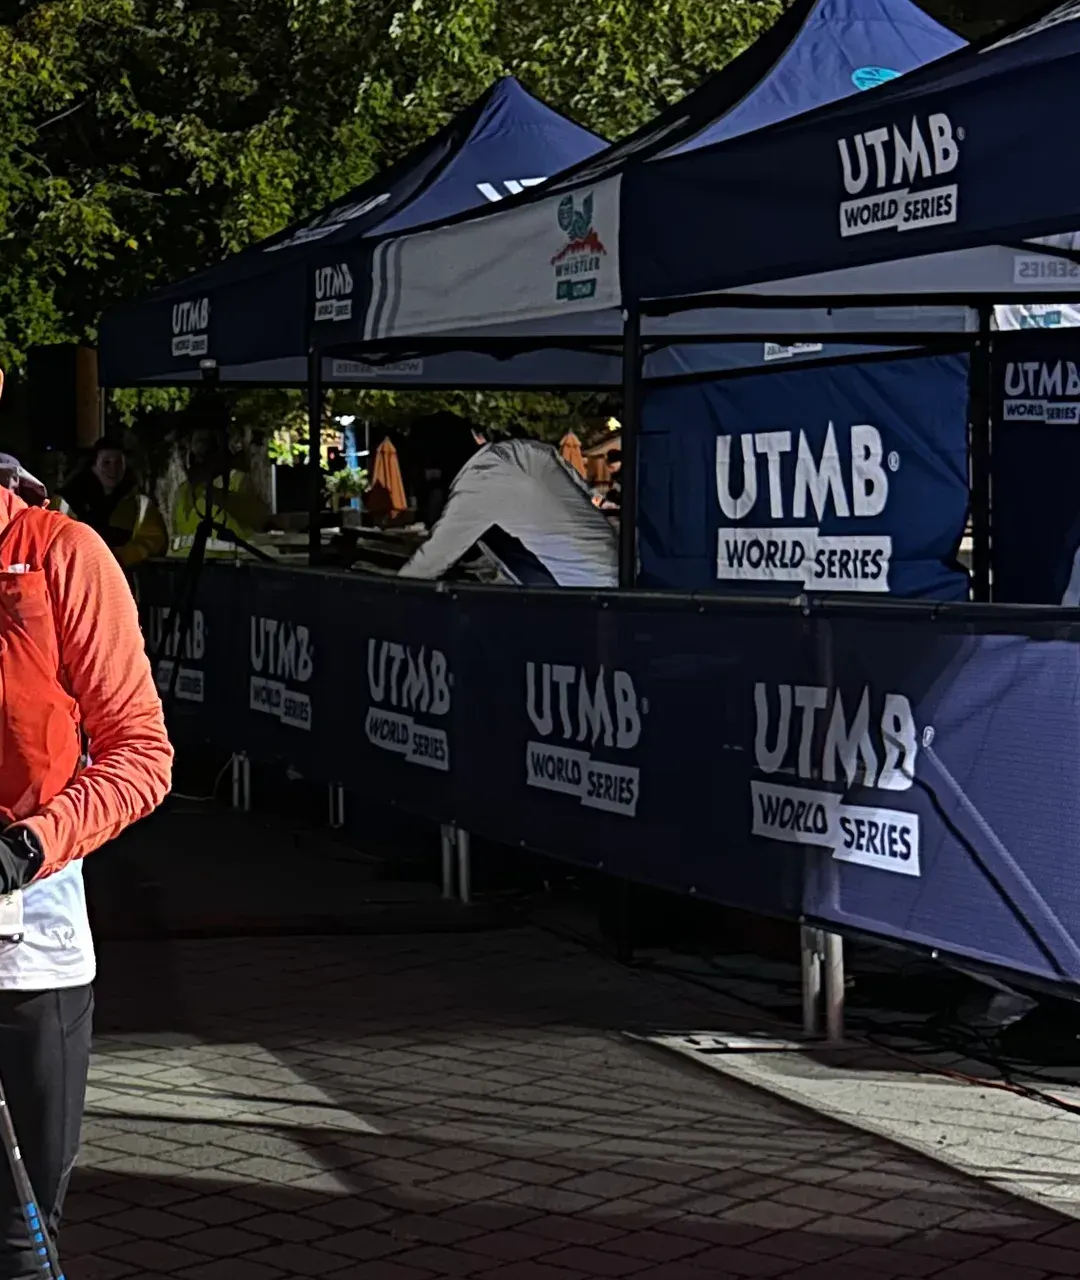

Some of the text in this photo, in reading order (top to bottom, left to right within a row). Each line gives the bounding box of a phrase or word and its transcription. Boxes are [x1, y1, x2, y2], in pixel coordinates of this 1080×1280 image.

[837, 113, 959, 195] UTMB
[844, 193, 953, 228] WORLD SERIES
[315, 263, 354, 299] UTMB
[172, 297, 209, 334] UTMB
[1004, 359, 1080, 397] UTMB
[1006, 403, 1078, 420] WORLD SERIES
[716, 420, 888, 523] UTMB
[725, 539, 884, 580] WORLD SERIES
[251, 615, 313, 682] UTMB
[367, 637, 451, 716] UTMB
[283, 696, 310, 723] SERIES
[526, 661, 642, 750] UTMB
[369, 715, 445, 762] WORLD SERIES
[754, 682, 918, 792] UTMB
[531, 750, 635, 806] WORLD SERIES
[759, 793, 912, 861] WORLD SERIES
